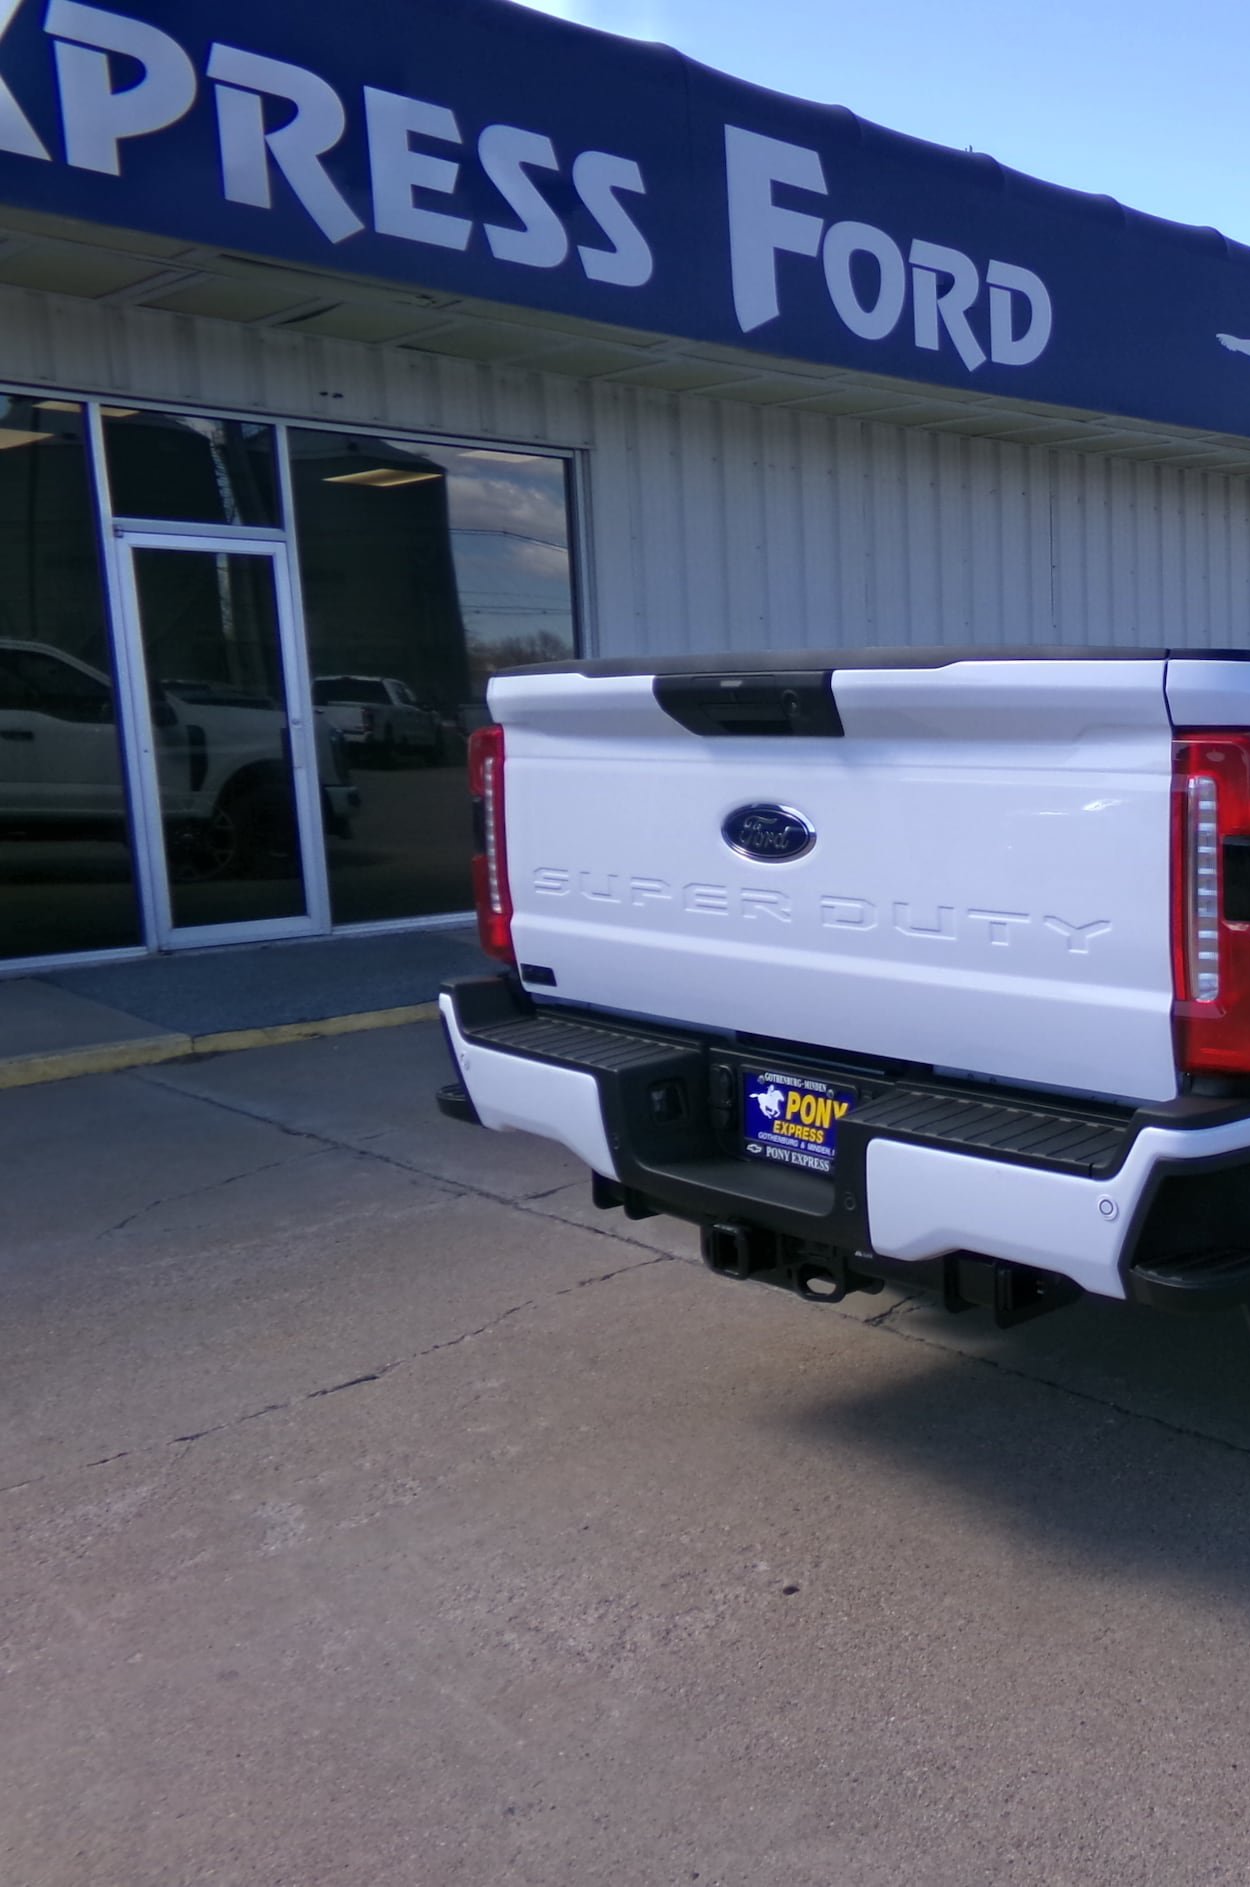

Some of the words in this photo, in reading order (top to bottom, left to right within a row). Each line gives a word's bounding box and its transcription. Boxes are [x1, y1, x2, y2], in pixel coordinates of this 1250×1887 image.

[724, 123, 1052, 372] FORD
[739, 815, 794, 849] Ford
[532, 866, 792, 923] SUPER
[819, 895, 1112, 955] DUTY
[785, 1091, 849, 1128] PONY
[772, 1120, 824, 1144] EXPRESS
[766, 1146, 791, 1162] PONY
[791, 1154, 830, 1172] EXPRESS
